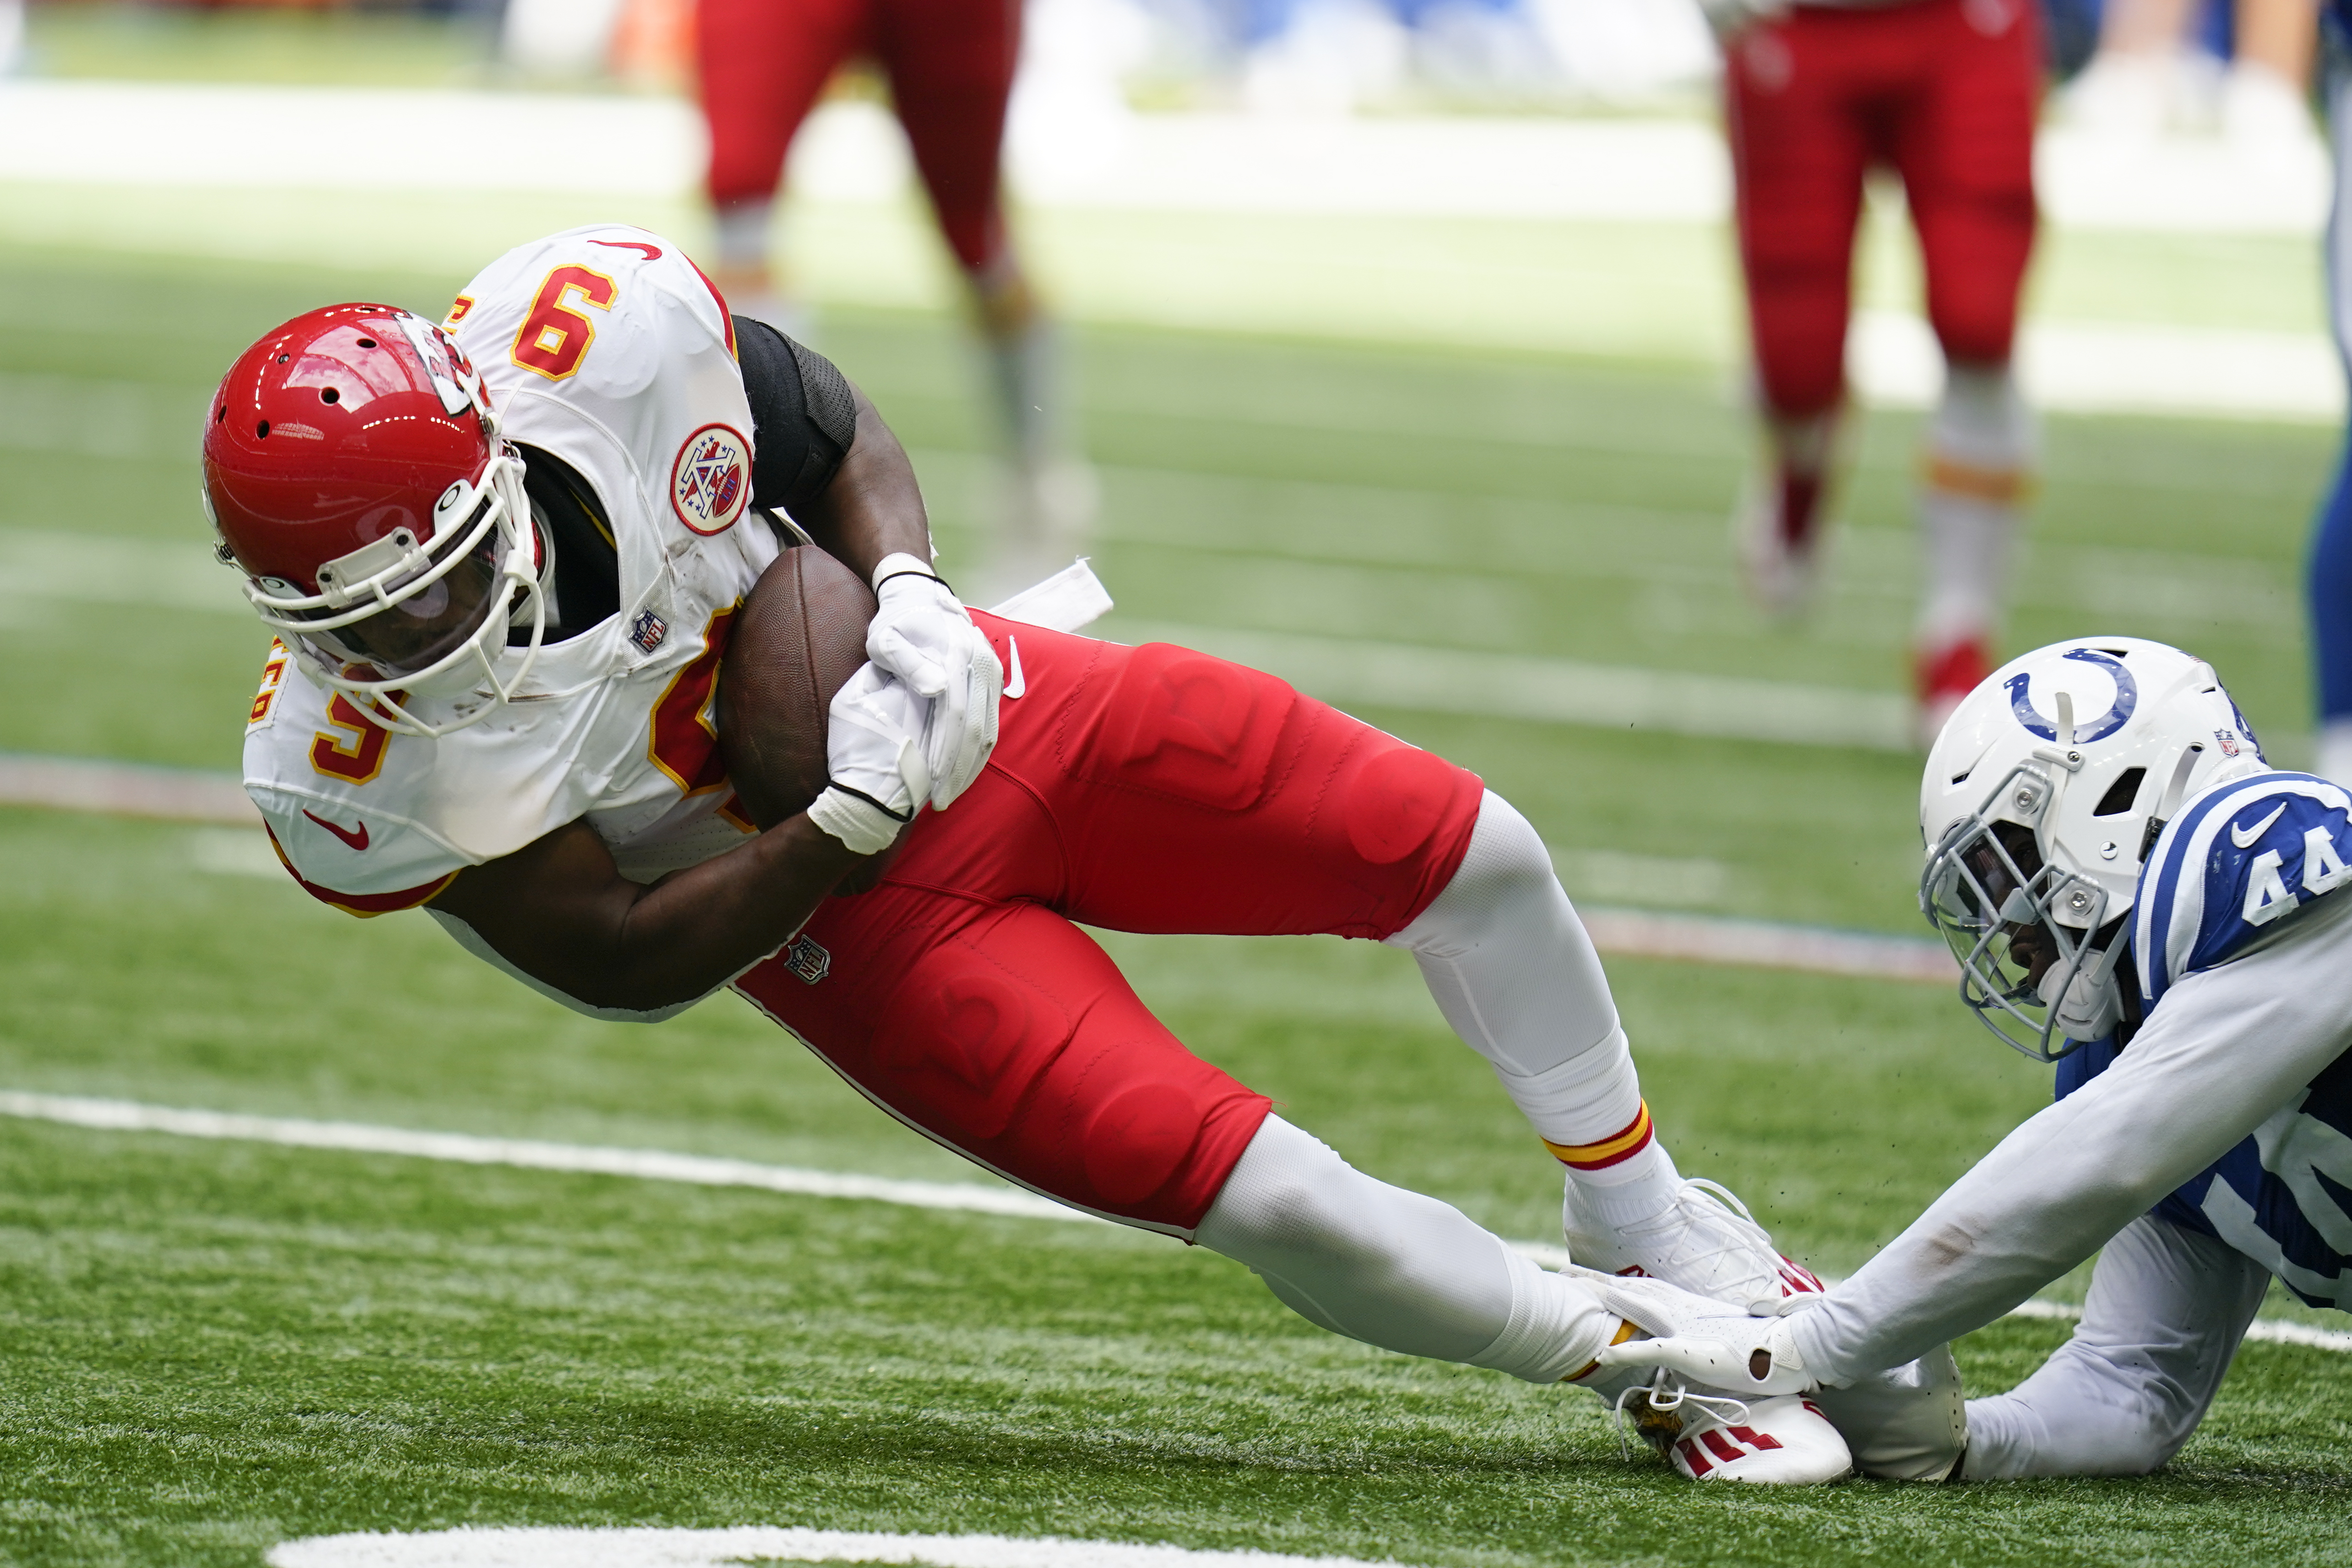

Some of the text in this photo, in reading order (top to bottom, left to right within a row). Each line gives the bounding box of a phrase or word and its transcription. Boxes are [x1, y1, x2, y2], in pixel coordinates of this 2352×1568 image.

[721, 477, 737, 502] LH
[642, 623, 664, 649] NFL
[2220, 741, 2238, 755] NFL
[2242, 825, 2352, 927] 44
[799, 951, 824, 978] NFL
